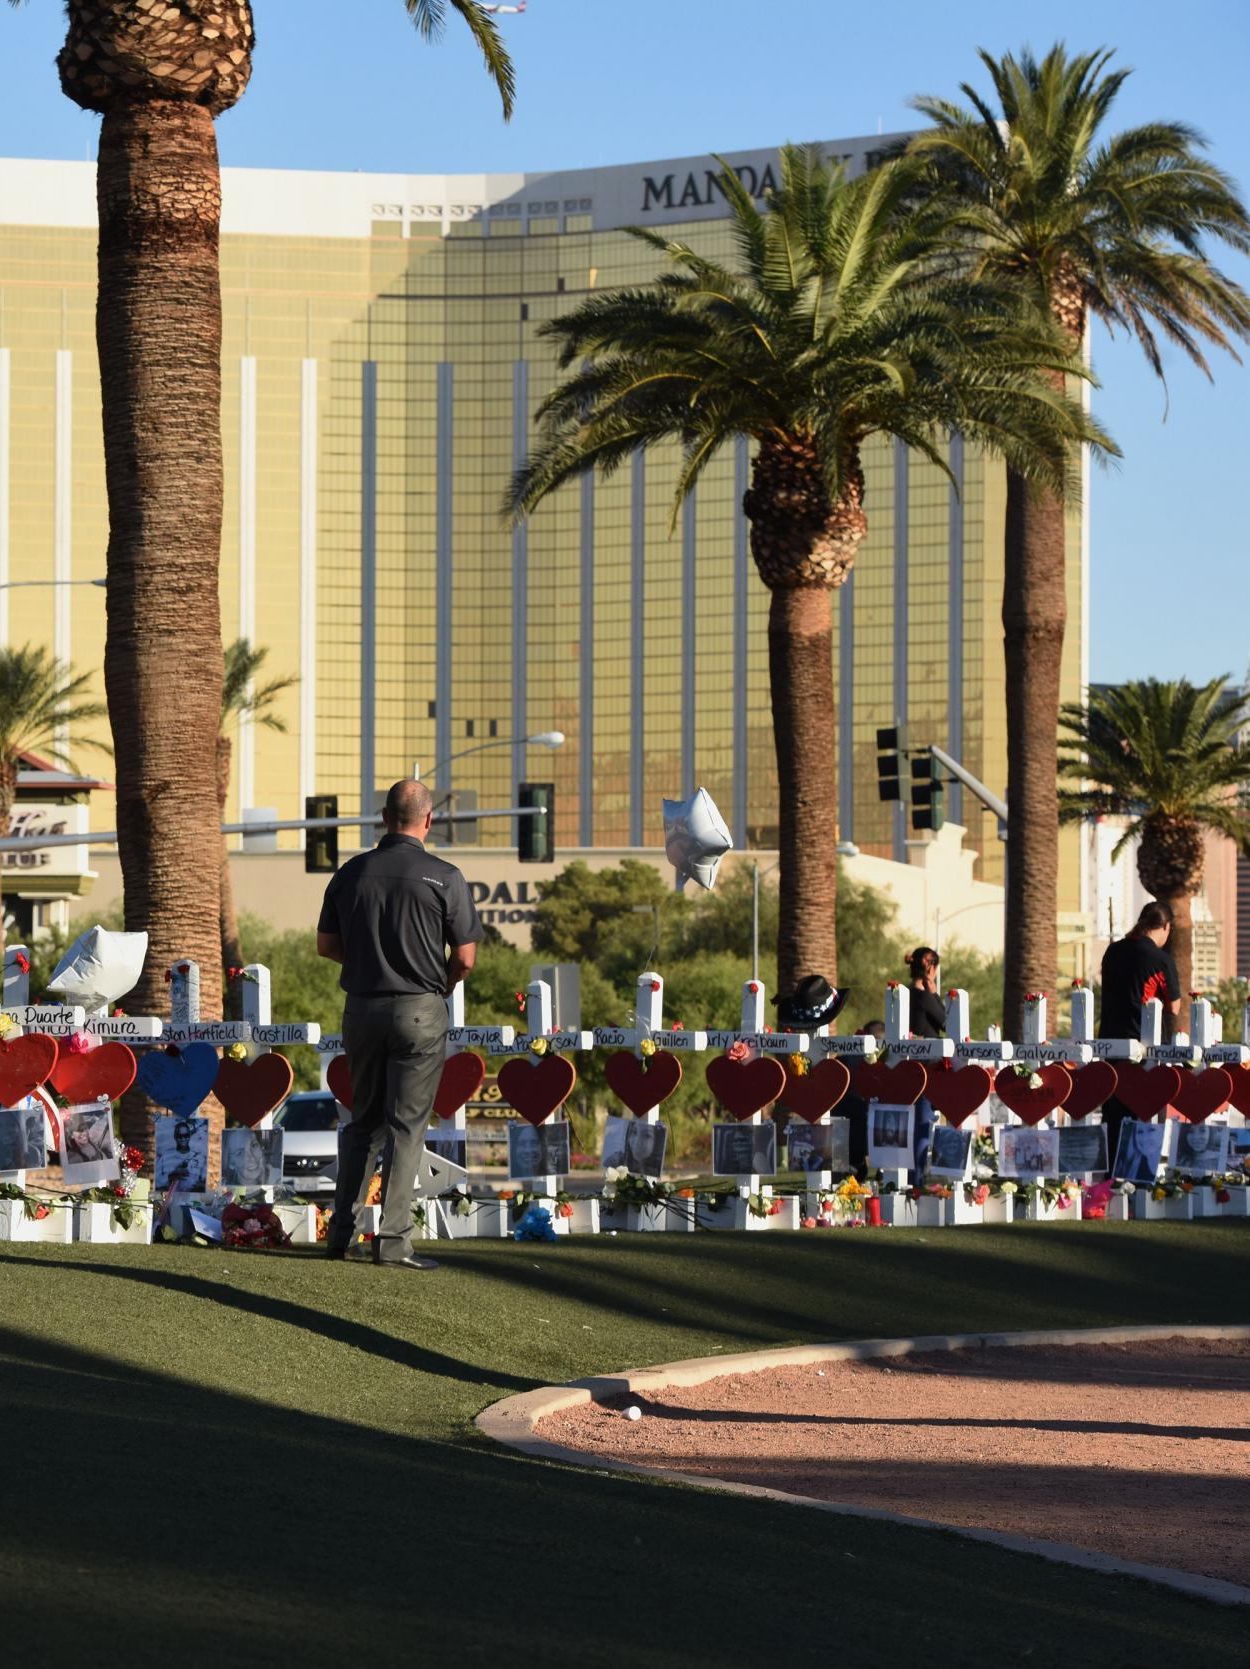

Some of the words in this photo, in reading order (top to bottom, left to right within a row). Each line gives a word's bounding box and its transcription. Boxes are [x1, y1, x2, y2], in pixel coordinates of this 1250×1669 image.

[24, 1005, 75, 1025] Duarte
[83, 1016, 139, 1036] Kimura
[251, 1024, 304, 1042] Castilla
[652, 1031, 689, 1047] Guillen
